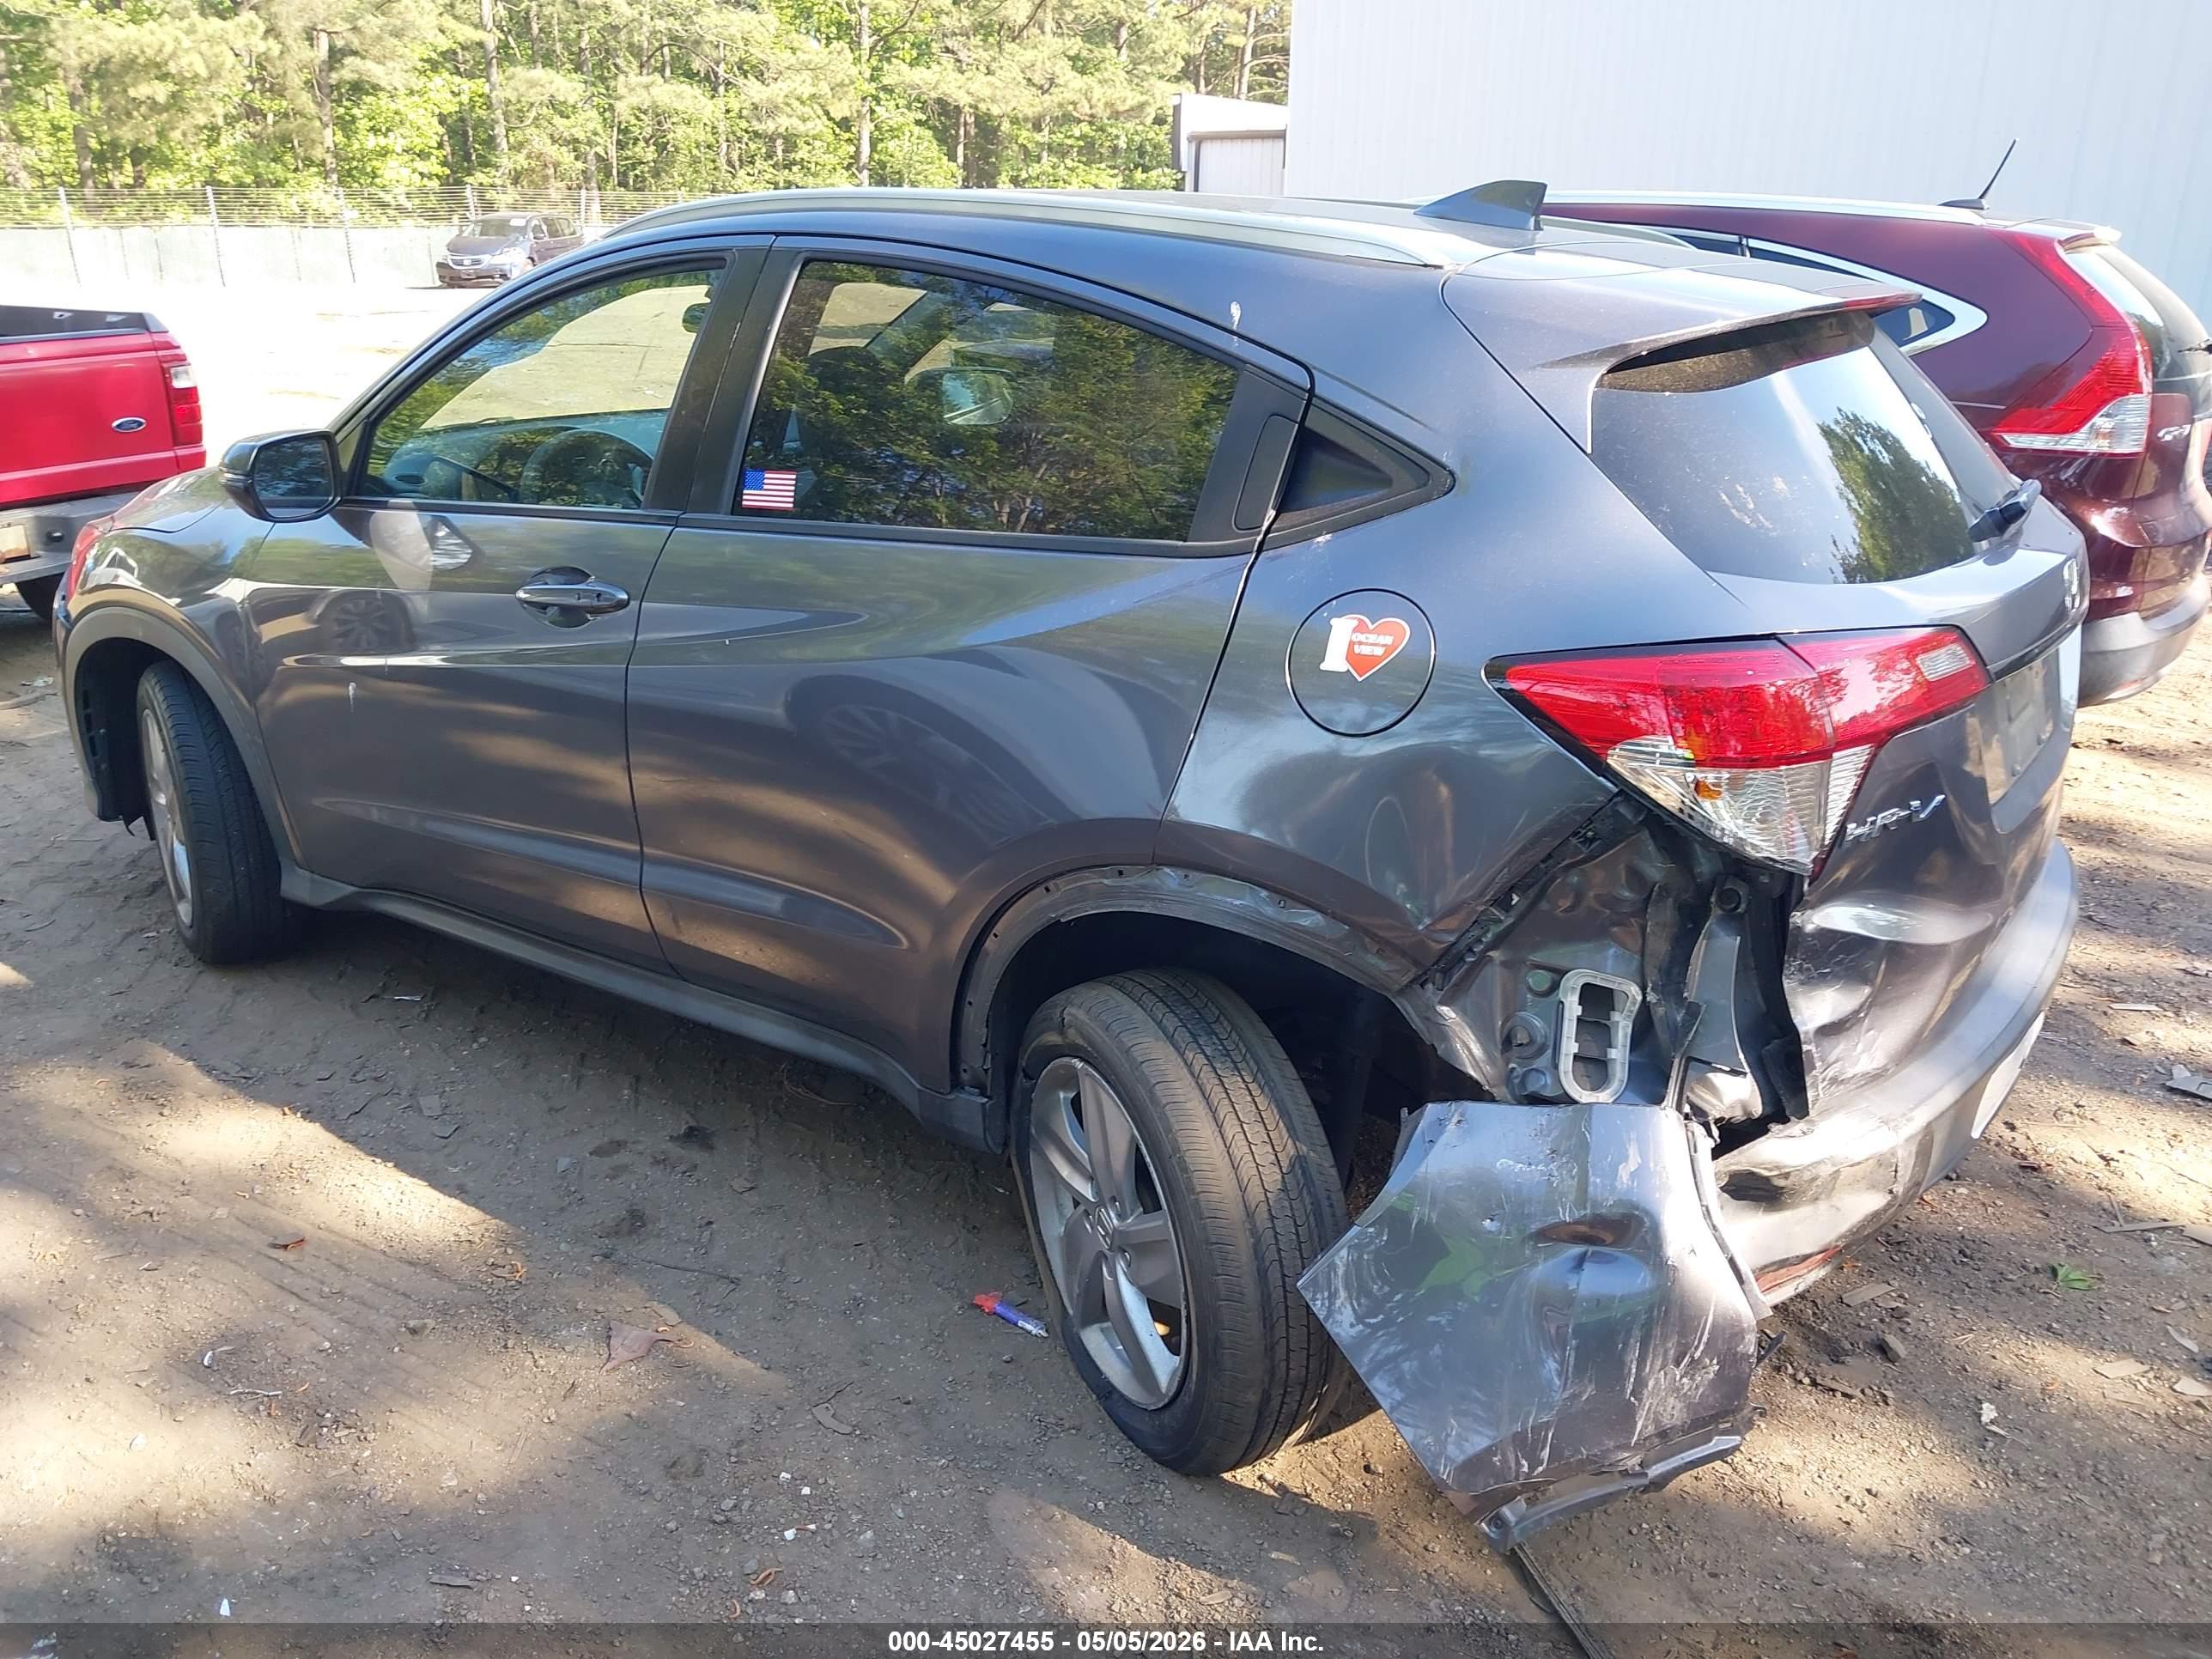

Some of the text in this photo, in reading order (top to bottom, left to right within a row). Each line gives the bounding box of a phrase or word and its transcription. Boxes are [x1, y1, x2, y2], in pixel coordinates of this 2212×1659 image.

[1319, 617, 1359, 672] I
[1352, 633, 1395, 646] OCEAN
[1353, 644, 1386, 656] VIEW
[1844, 794, 1946, 842] HR-V
